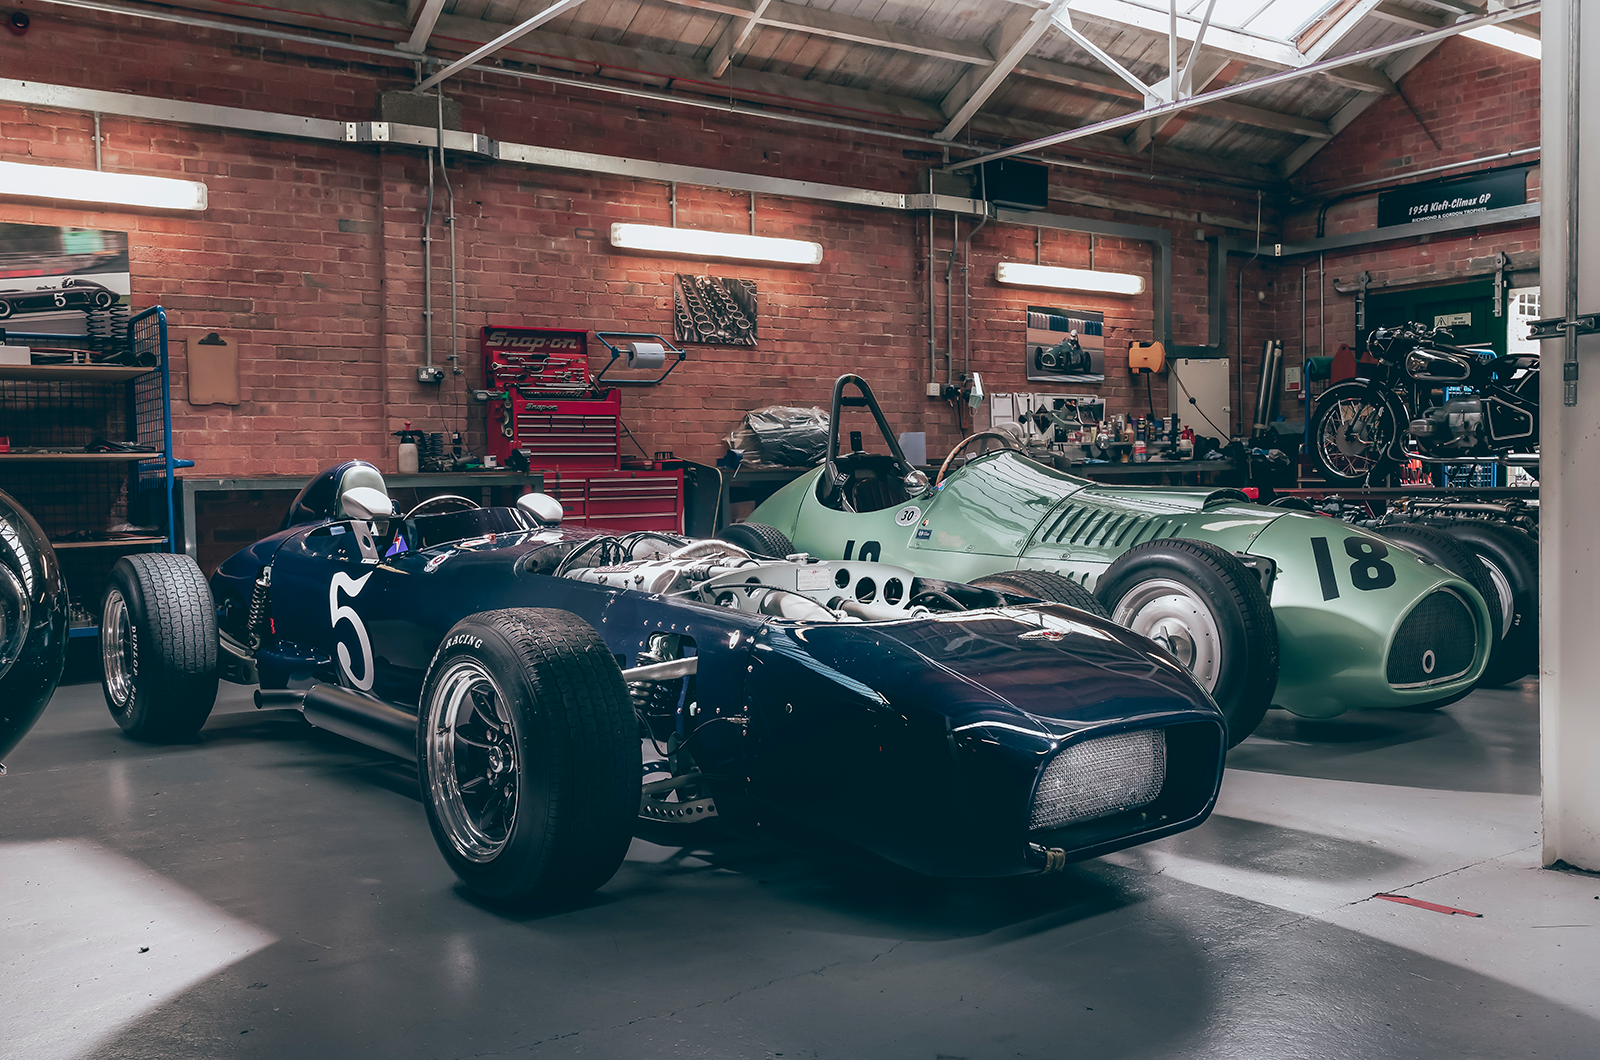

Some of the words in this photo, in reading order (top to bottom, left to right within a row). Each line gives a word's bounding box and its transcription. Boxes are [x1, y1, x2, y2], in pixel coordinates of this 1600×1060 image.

[1408, 204, 1429, 215] 1954
[1430, 197, 1478, 212] Kieft-Climax
[1479, 193, 1491, 204] GP
[1411, 214, 1437, 223] RICHMOND
[1464, 206, 1487, 214] TROPHIES
[53, 292, 67, 307] 5
[485, 331, 577, 352] Snap-on
[525, 402, 558, 412] Snap-on
[900, 510, 915, 521] 30
[1310, 536, 1397, 602] 18
[329, 571, 375, 691] 5
[131, 625, 139, 676] DUNLOP
[445, 634, 483, 649] RACING
